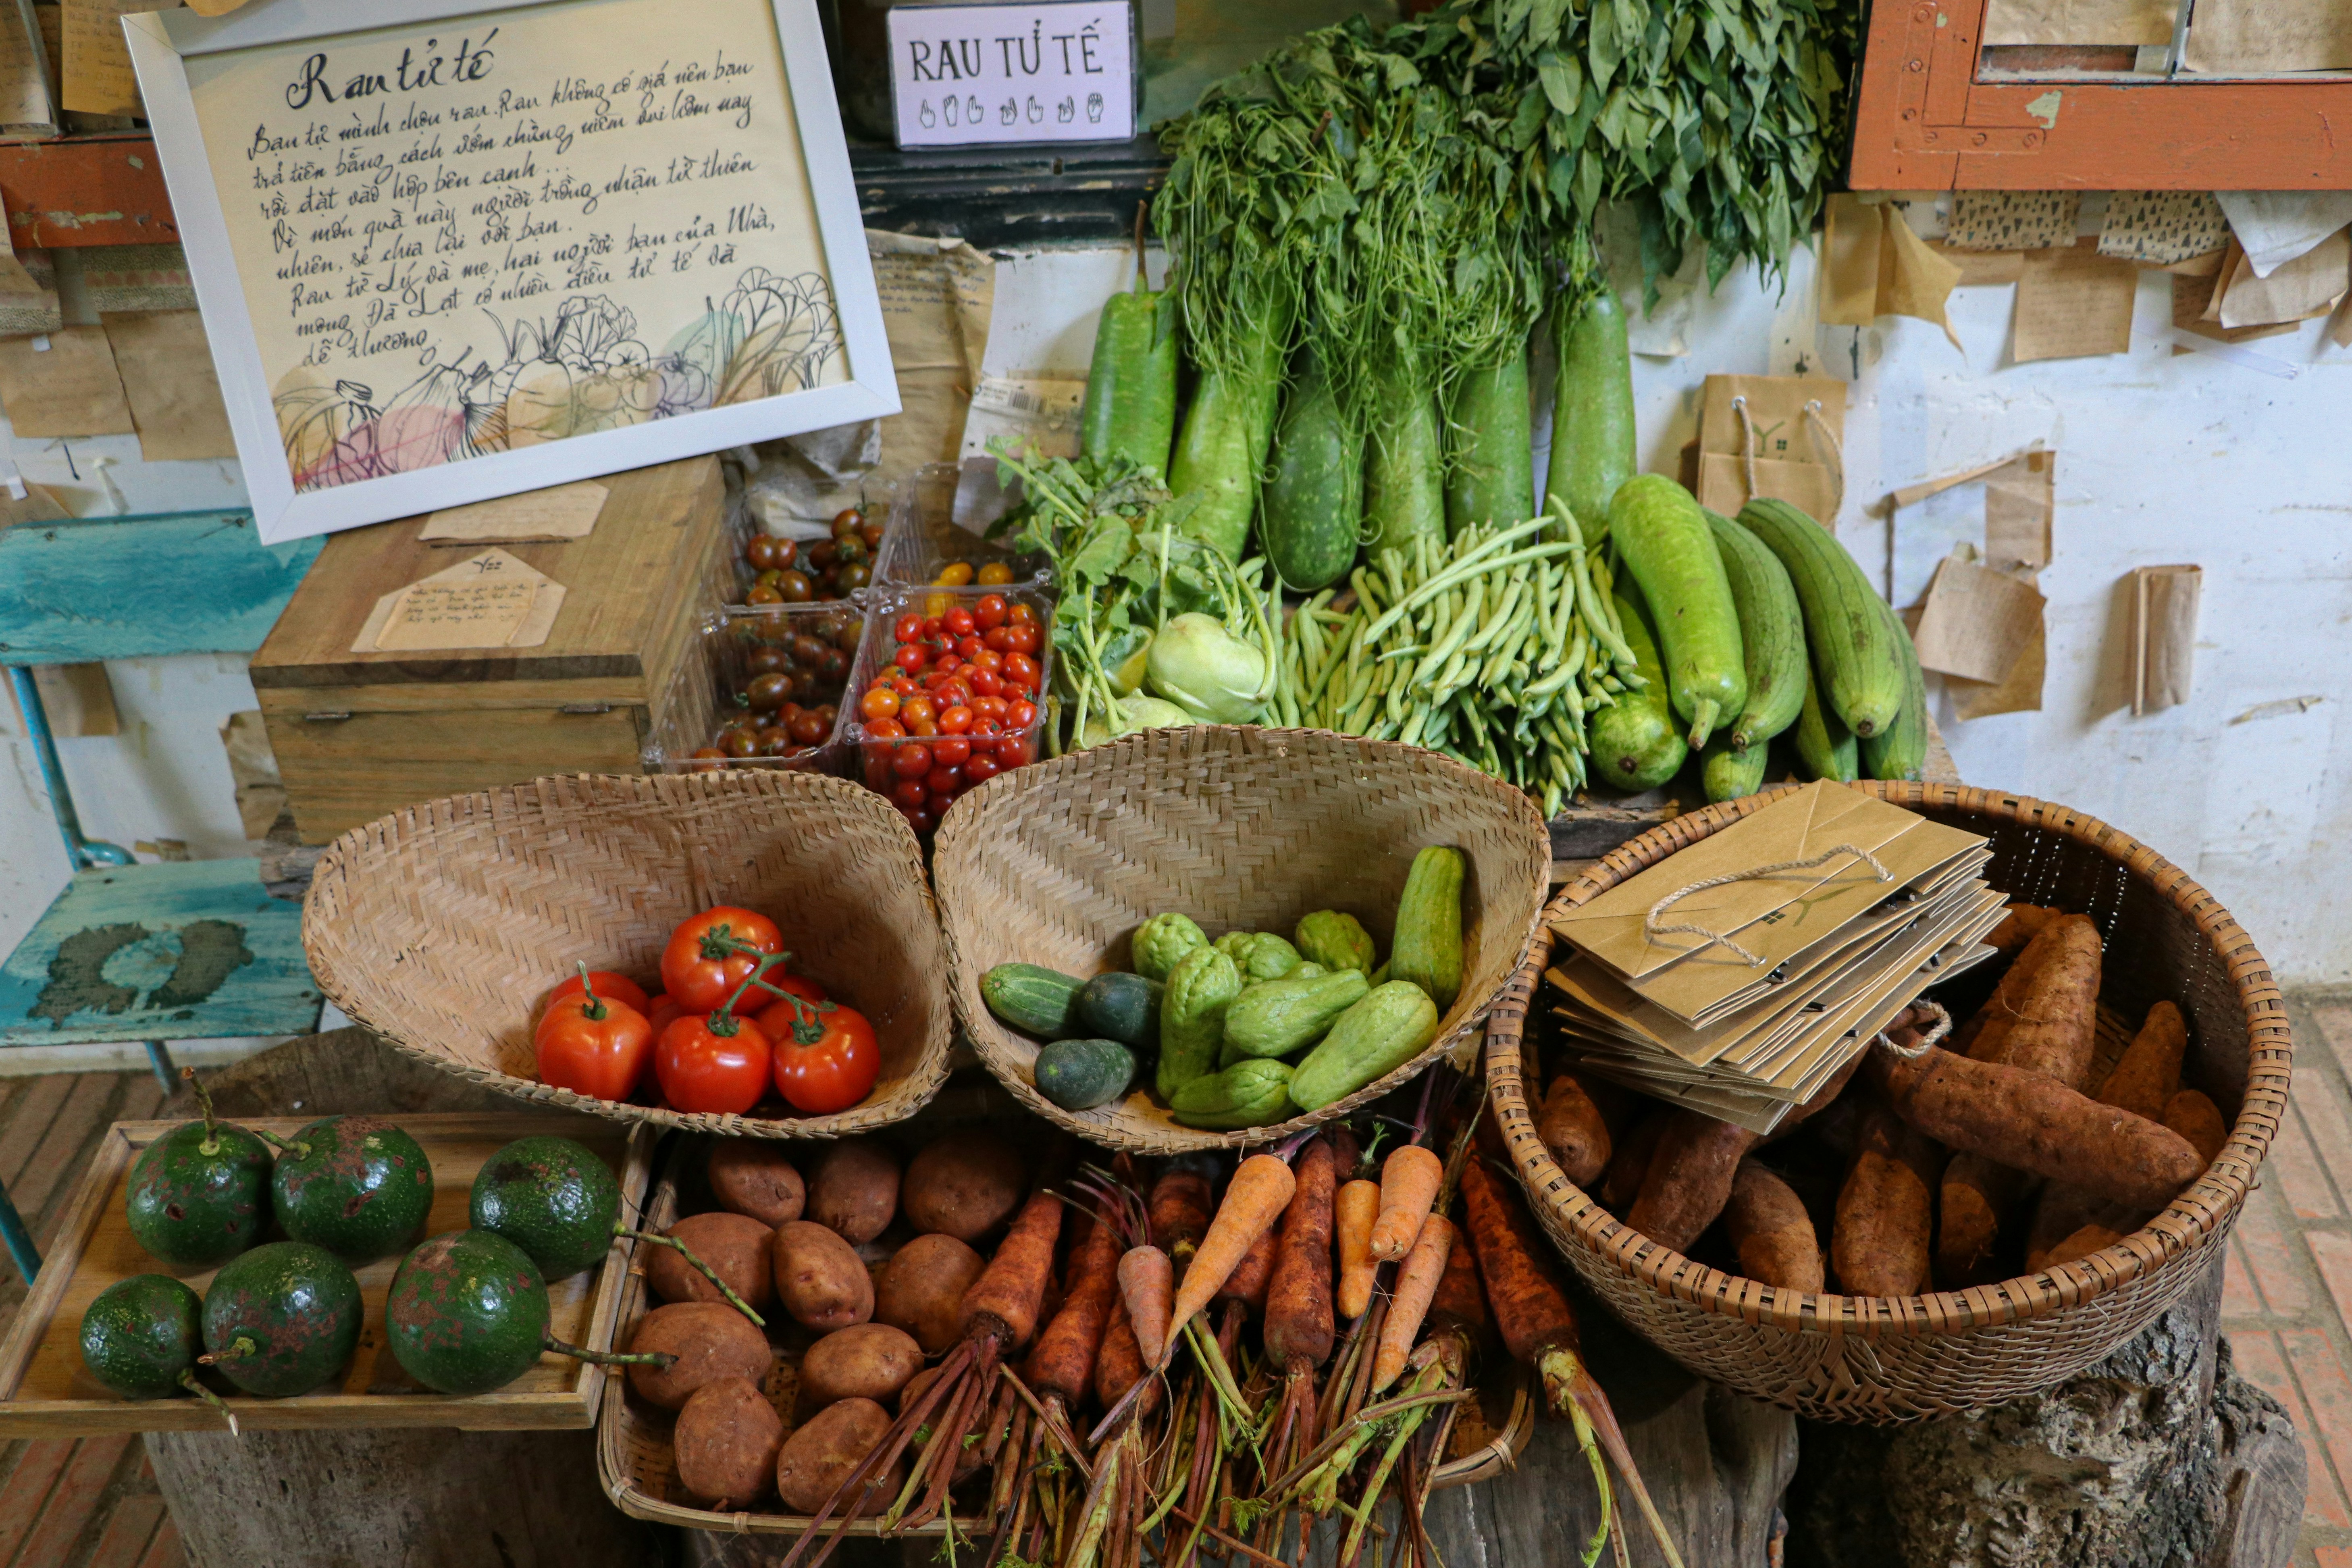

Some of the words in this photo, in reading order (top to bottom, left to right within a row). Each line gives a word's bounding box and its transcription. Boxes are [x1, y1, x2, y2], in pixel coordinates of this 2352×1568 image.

[287, 54, 391, 109] Rau
[398, 39, 447, 91] tử
[452, 27, 498, 81] tế
[910, 38, 982, 81] RAU
[995, 19, 1042, 77] TỬ
[1052, 17, 1103, 75] TẾ
[248, 124, 298, 160] Bạn
[306, 123, 330, 150] tự
[339, 102, 390, 138] mình
[399, 101, 440, 135] chọn
[499, 89, 541, 117] Rau
[551, 77, 610, 115] không
[610, 70, 634, 96] có
[636, 60, 670, 108] giá
[674, 62, 711, 86] nên
[713, 50, 753, 83] bạn
[253, 161, 285, 189] trả
[289, 162, 327, 183] tiền
[335, 146, 393, 185] bằng
[398, 133, 443, 164] cách
[503, 119, 574, 154] chừng
[672, 89, 709, 120] hôm
[717, 95, 752, 129] nay
[261, 191, 289, 220] rồi
[297, 186, 338, 217] đặt
[348, 184, 379, 206] vào
[394, 174, 427, 212] hộp
[433, 164, 470, 193] bên
[480, 151, 537, 189] cạnh
[272, 218, 298, 255] Vì
[310, 214, 354, 243] món
[363, 209, 405, 247] quà
[416, 200, 455, 237] này
[472, 185, 534, 227] người
[540, 174, 603, 214] trồng
[605, 163, 660, 194] nhận
[666, 155, 698, 184] từ
[699, 149, 759, 179] thiên
[276, 249, 343, 279] nhiên,
[351, 245, 371, 267] sẻ
[380, 233, 423, 262] chia
[435, 227, 465, 256] lại
[481, 215, 512, 245] với
[291, 283, 333, 317] Rau
[345, 272, 374, 298] từ
[376, 261, 422, 304] Lý
[426, 261, 451, 284] và
[461, 261, 499, 279] mẹ,
[504, 243, 544, 271] hai
[624, 223, 666, 254] bạn
[673, 215, 717, 243] của
[728, 202, 776, 233] Nhà,
[363, 298, 399, 329] Đà
[409, 287, 464, 317] Lạt
[473, 279, 495, 306] có
[501, 271, 556, 302] nhiều
[564, 261, 614, 290] điều
[628, 251, 657, 279] tử
[672, 241, 701, 272] tế
[709, 243, 738, 267] và
[302, 338, 333, 366] dễ
